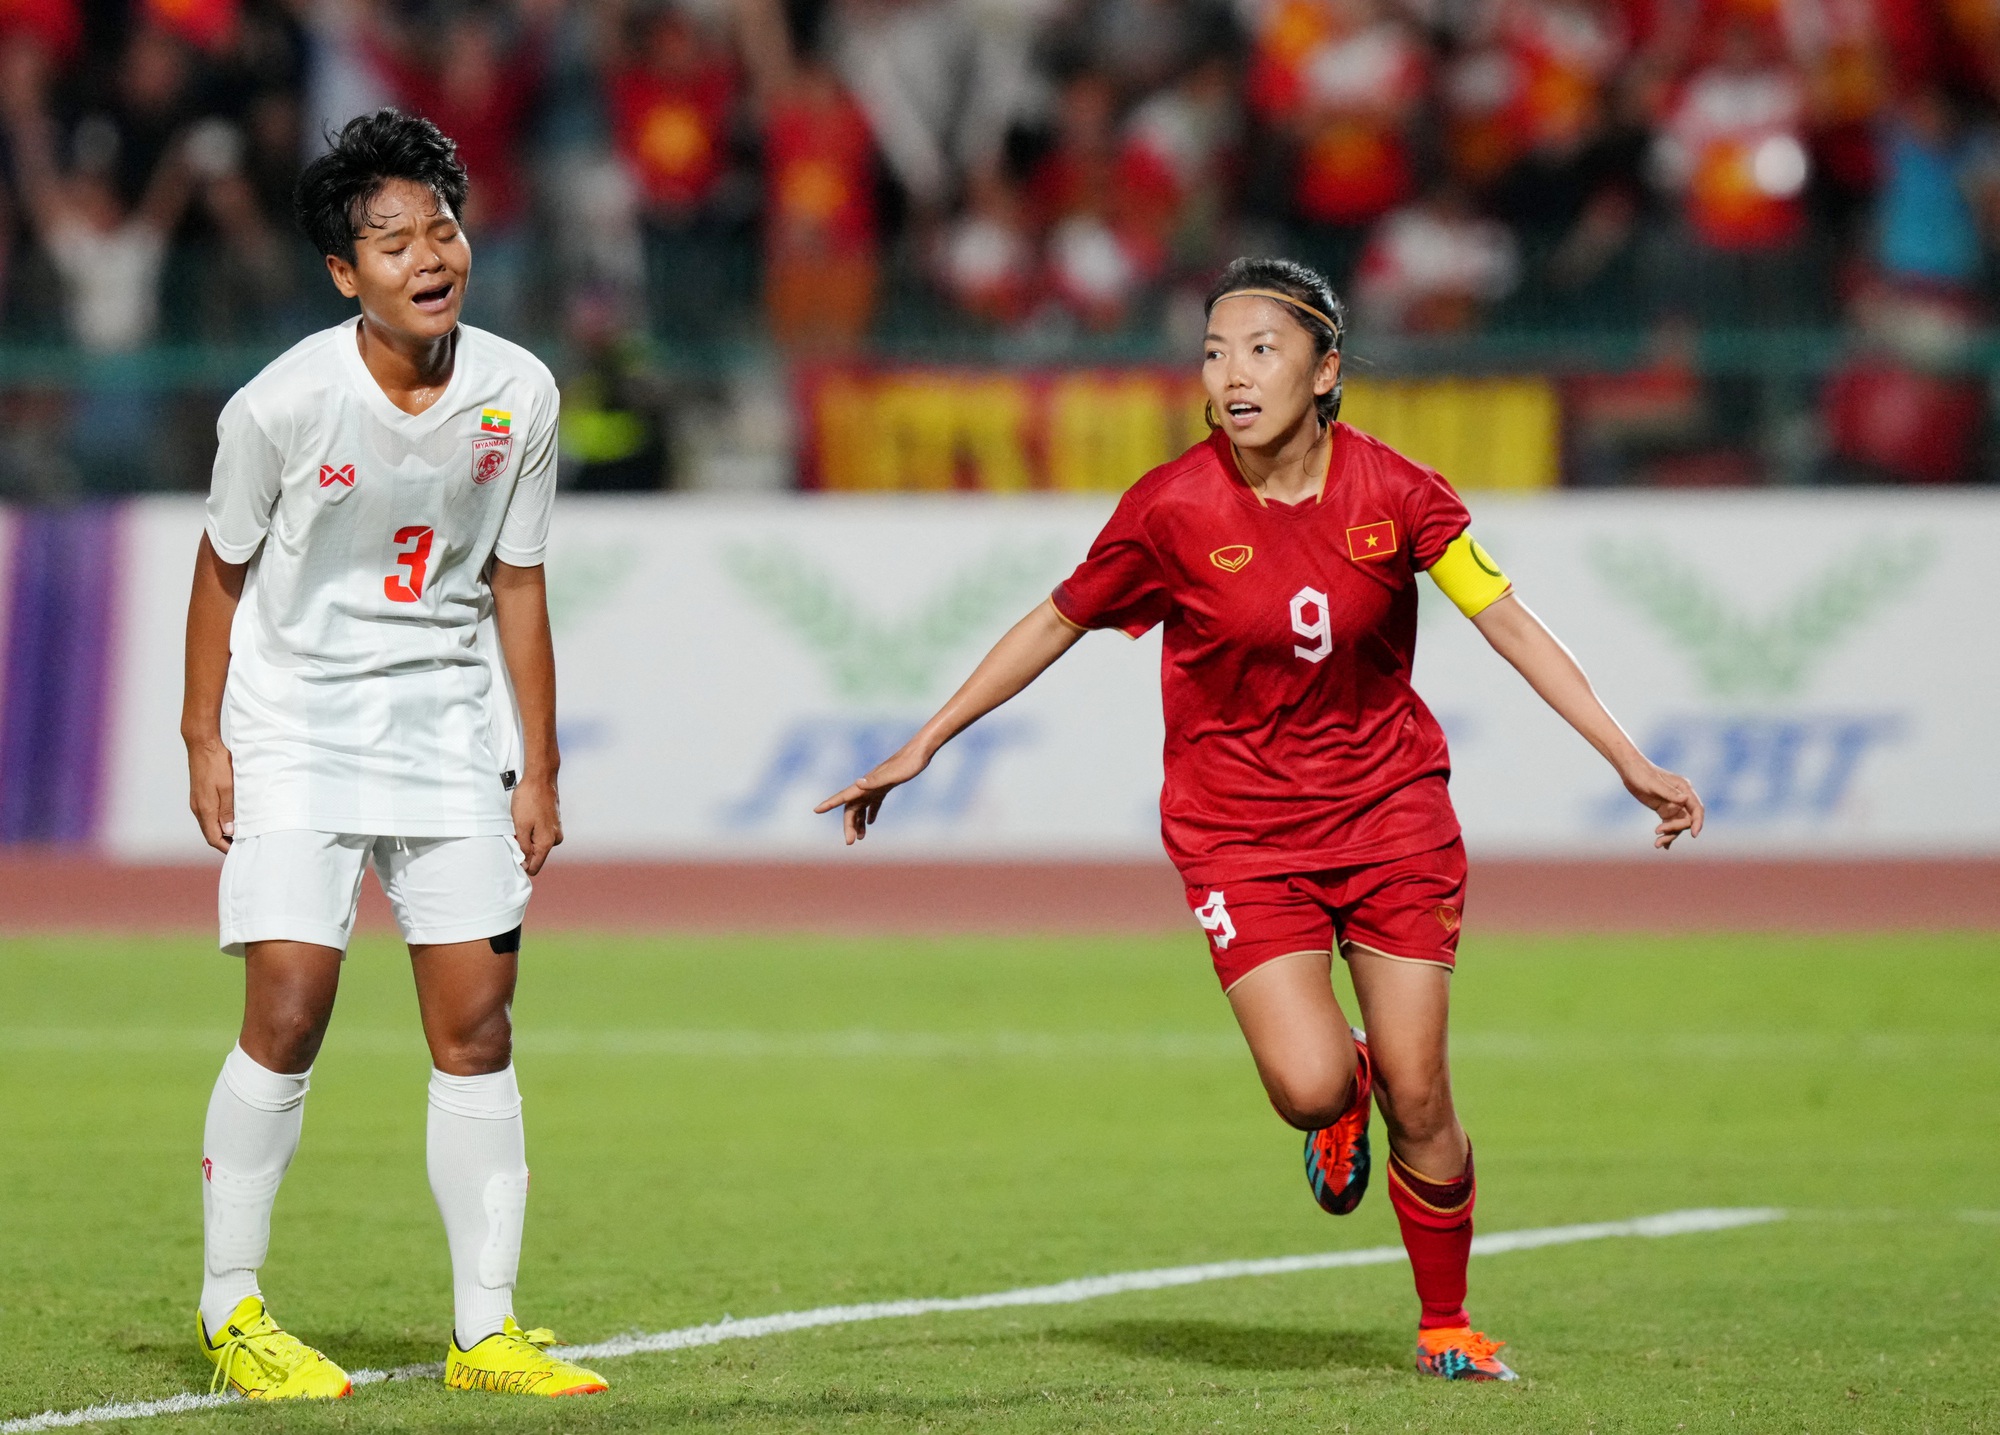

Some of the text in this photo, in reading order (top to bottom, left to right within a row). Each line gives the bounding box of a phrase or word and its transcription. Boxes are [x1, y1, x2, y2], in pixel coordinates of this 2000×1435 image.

[475, 439, 510, 449] MYANMAR
[384, 525, 435, 603] 3
[1289, 585, 1333, 664] 9
[1194, 890, 1237, 950] 9
